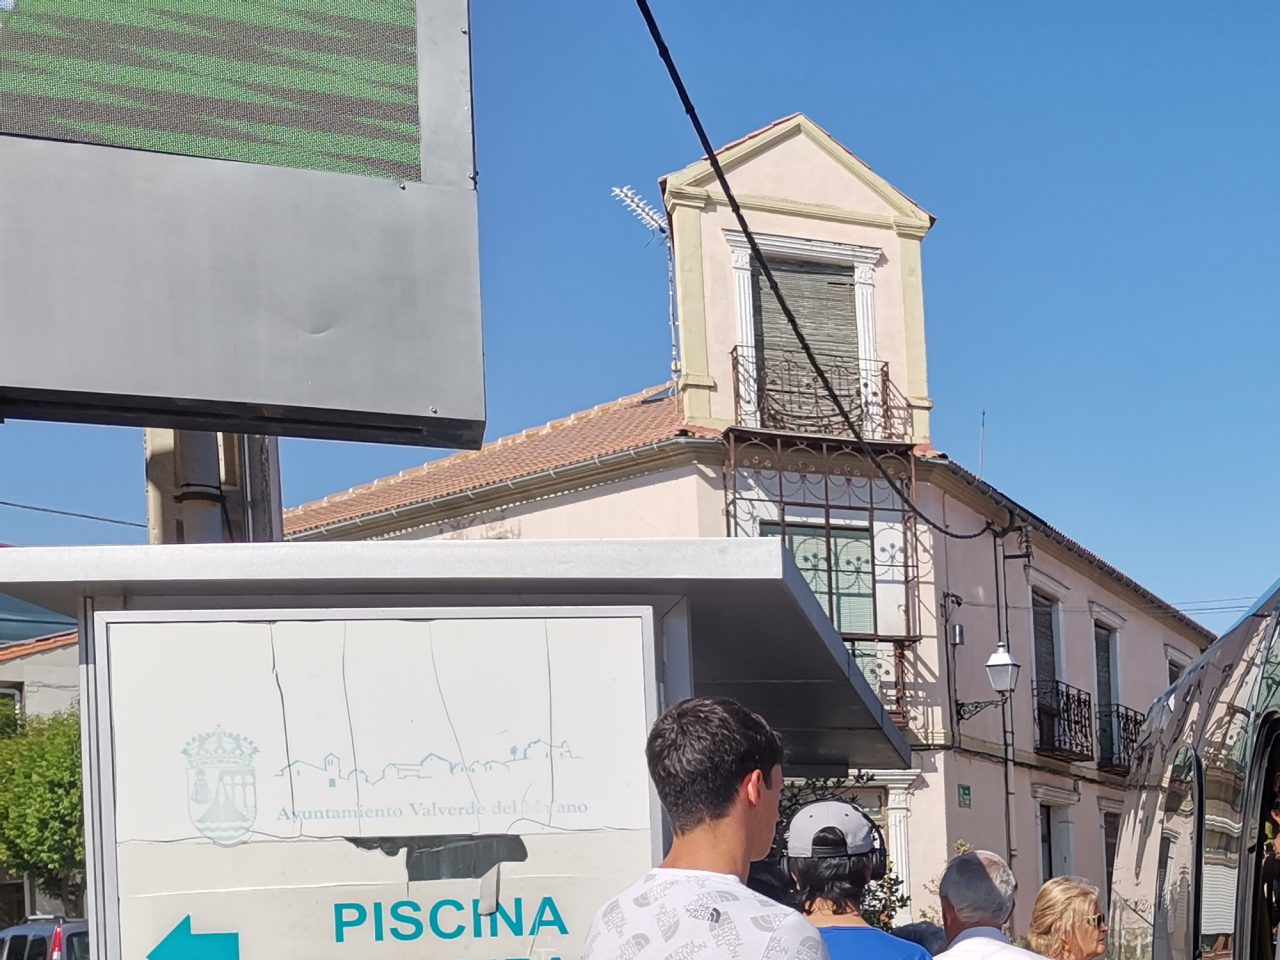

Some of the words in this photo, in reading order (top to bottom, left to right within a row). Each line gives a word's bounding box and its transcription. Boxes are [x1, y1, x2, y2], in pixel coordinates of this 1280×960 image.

[277, 806, 404, 823] Ayuntamiento
[409, 802, 486, 817] Valverde
[492, 800, 517, 815] del
[334, 897, 569, 943] PISCINA
